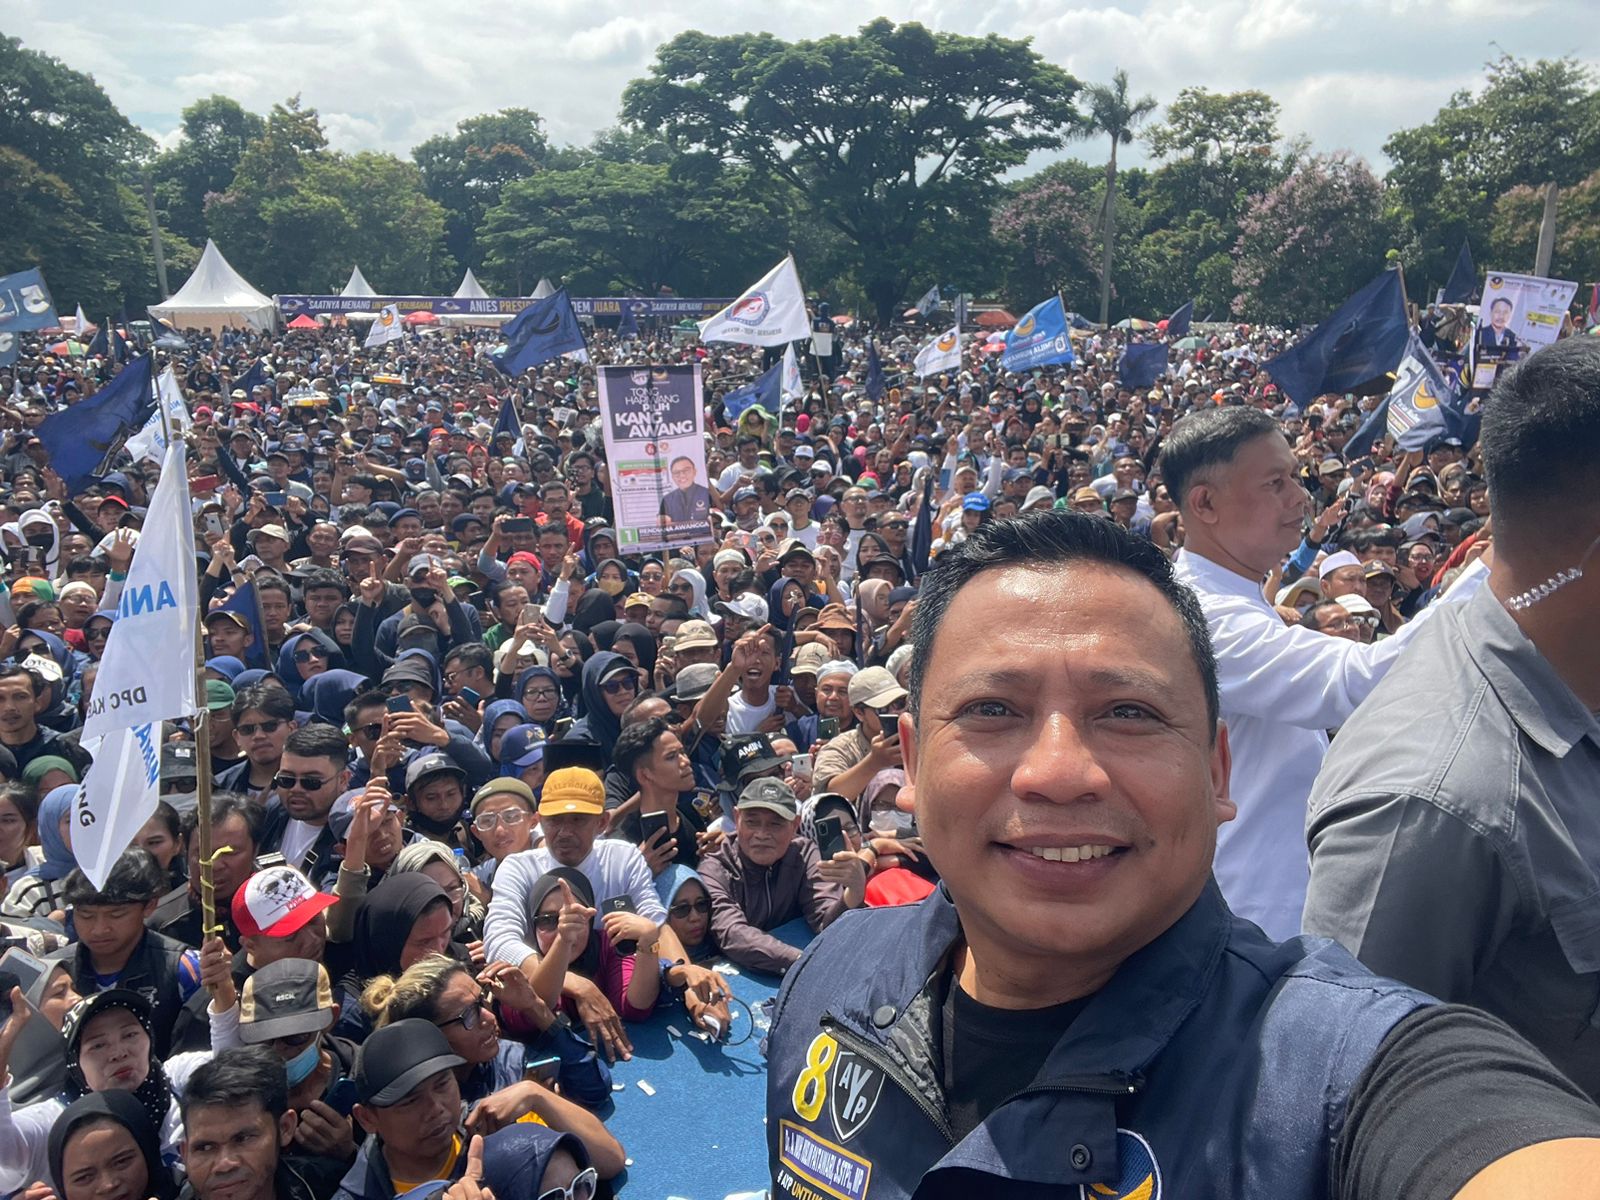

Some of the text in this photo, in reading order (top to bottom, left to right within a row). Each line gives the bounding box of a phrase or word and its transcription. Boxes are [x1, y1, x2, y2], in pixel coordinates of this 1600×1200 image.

[341, 301, 370, 310] MENANG
[469, 301, 498, 313] ANIES
[593, 301, 620, 313] JUARA
[630, 387, 659, 397] TONG
[642, 403, 670, 413] PILIH
[615, 412, 663, 426] KANG
[629, 420, 694, 438] AWANG
[624, 530, 633, 542] 1
[739, 741, 763, 759] AMIN
[793, 1032, 838, 1122] 8
[839, 1062, 873, 1123] AYP
[781, 1173, 794, 1191] AYP
